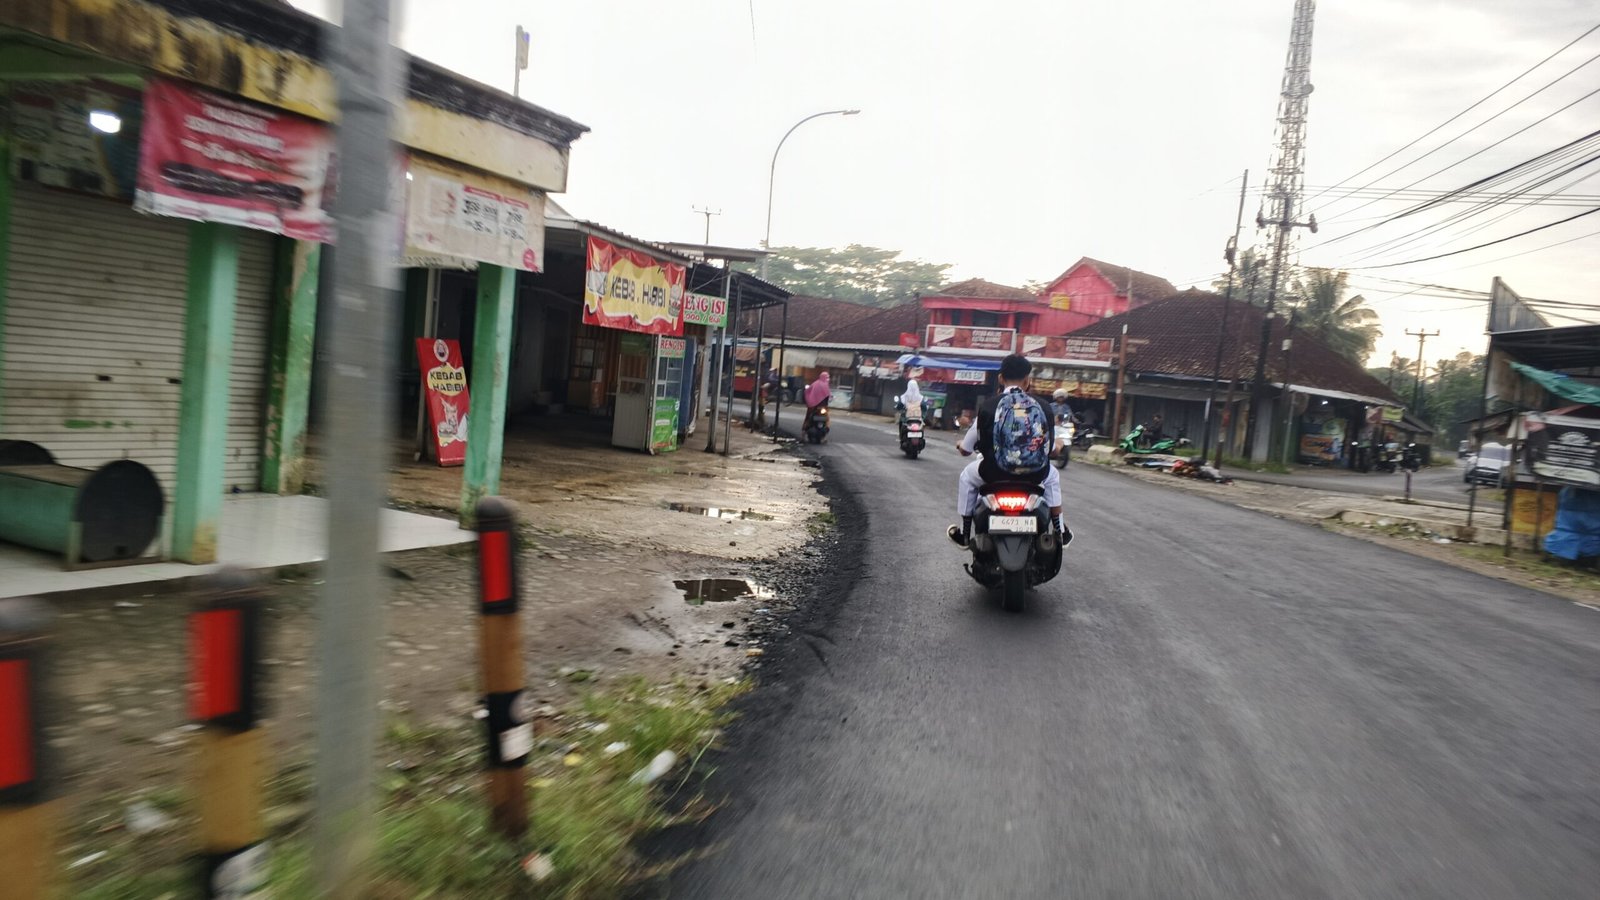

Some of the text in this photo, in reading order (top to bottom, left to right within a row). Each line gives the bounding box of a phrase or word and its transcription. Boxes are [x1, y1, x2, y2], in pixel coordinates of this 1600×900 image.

[642, 283, 666, 308] HBBI
[684, 295, 726, 315] ENG ISI
[685, 313, 700, 321] 000
[429, 371, 463, 381] KEBAB
[432, 382, 465, 392] HABIBI
